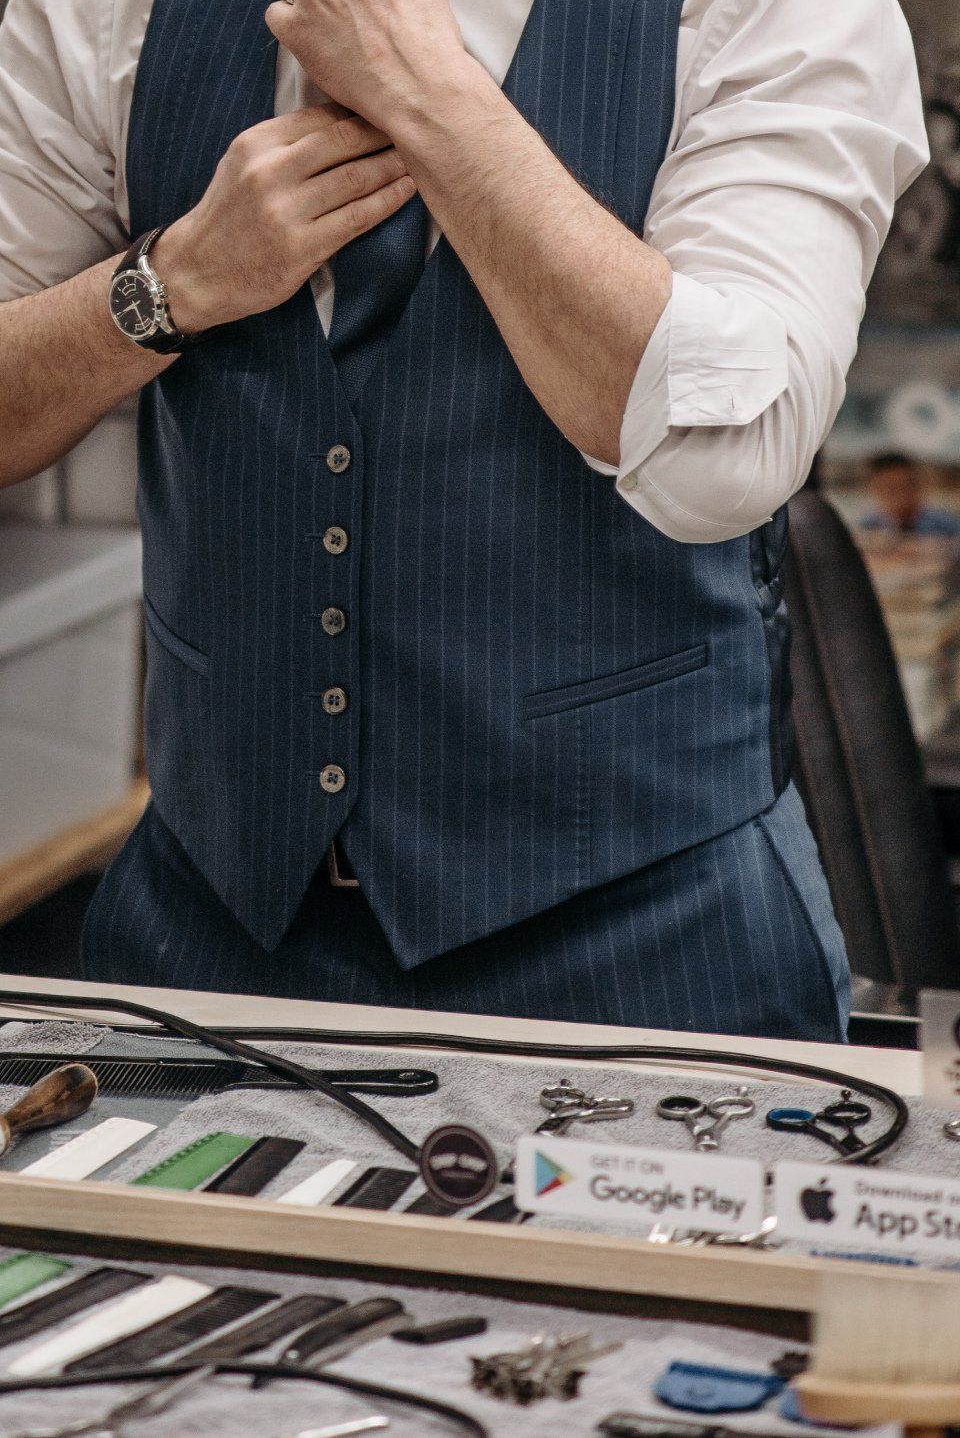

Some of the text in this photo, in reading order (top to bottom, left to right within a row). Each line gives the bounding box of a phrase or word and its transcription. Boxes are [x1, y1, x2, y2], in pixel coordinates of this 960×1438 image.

[590, 1174, 747, 1222] Google Play
[855, 1202, 960, 1241] App St
